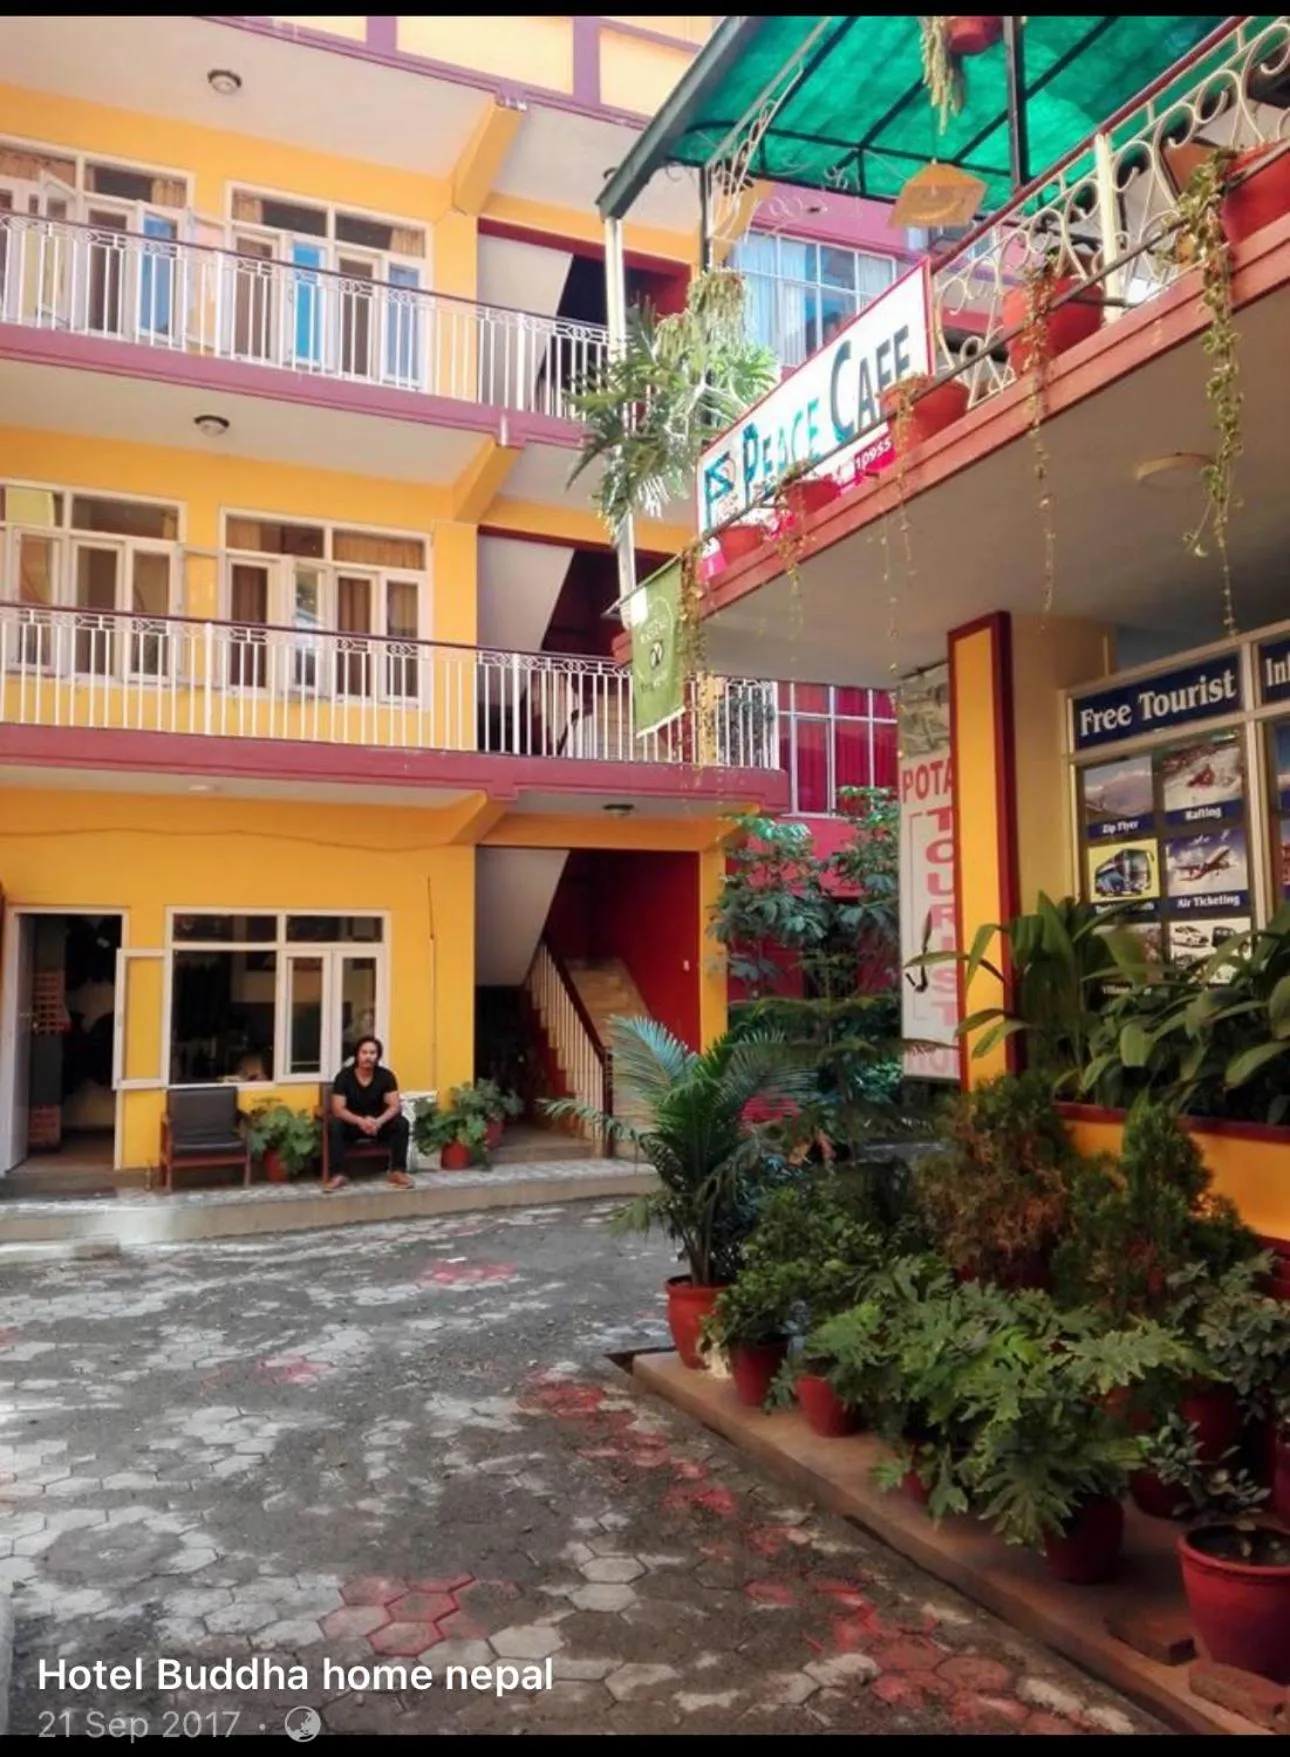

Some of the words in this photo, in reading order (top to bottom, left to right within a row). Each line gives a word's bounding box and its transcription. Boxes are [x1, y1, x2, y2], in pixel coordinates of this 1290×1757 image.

[742, 396, 822, 507] PEACE
[830, 324, 910, 443] CAFE
[1079, 703, 1132, 737] Free
[1138, 668, 1237, 720] Tourist
[1185, 806, 1221, 821] Rafting
[1102, 824, 1117, 835] Zip
[1177, 898, 1193, 908] Air
[1195, 894, 1241, 906] Ticketing
